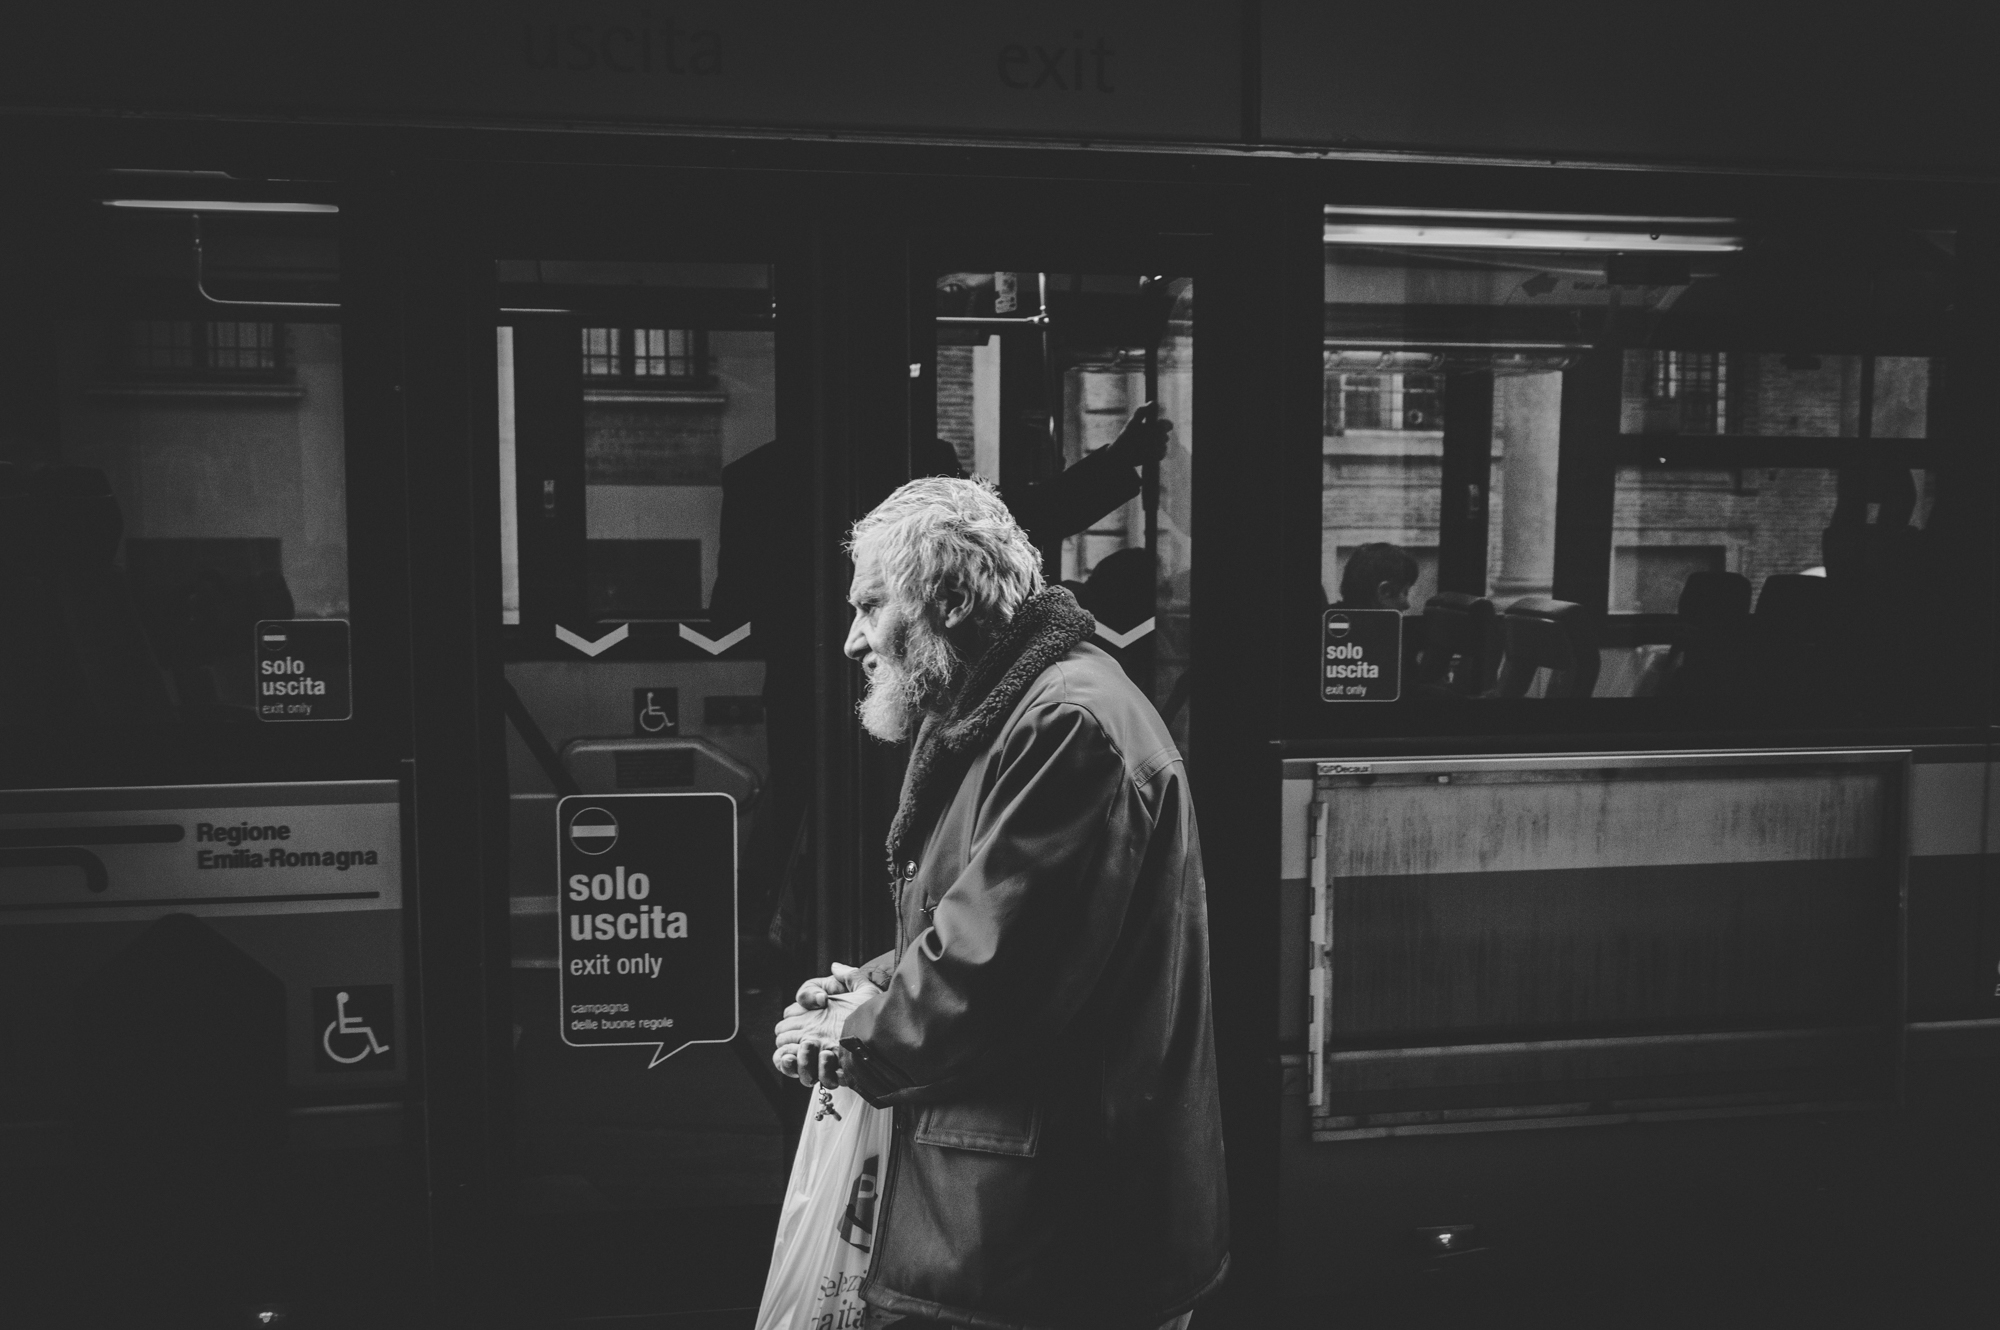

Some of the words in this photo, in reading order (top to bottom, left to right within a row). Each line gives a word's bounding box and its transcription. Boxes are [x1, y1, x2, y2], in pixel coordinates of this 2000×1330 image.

[523, 8, 722, 76] uscita
[997, 28, 1116, 93] exit
[1326, 642, 1363, 659] solo
[261, 656, 305, 675] solo
[1326, 661, 1379, 678] uscita
[262, 677, 325, 696] uscita
[1325, 684, 1344, 695] exit
[1346, 684, 1367, 697] only
[262, 703, 285, 714] exit
[287, 703, 312, 716] only
[196, 821, 291, 847] Regione
[197, 848, 378, 871] Emilia-Romagna
[568, 866, 650, 901] solo
[570, 905, 688, 940] uscita
[570, 954, 611, 976] exit
[616, 953, 663, 979] only
[571, 1003, 630, 1015] campagna
[571, 1019, 598, 1030] delle
[601, 1019, 636, 1029] buone
[639, 1017, 674, 1030] regole
